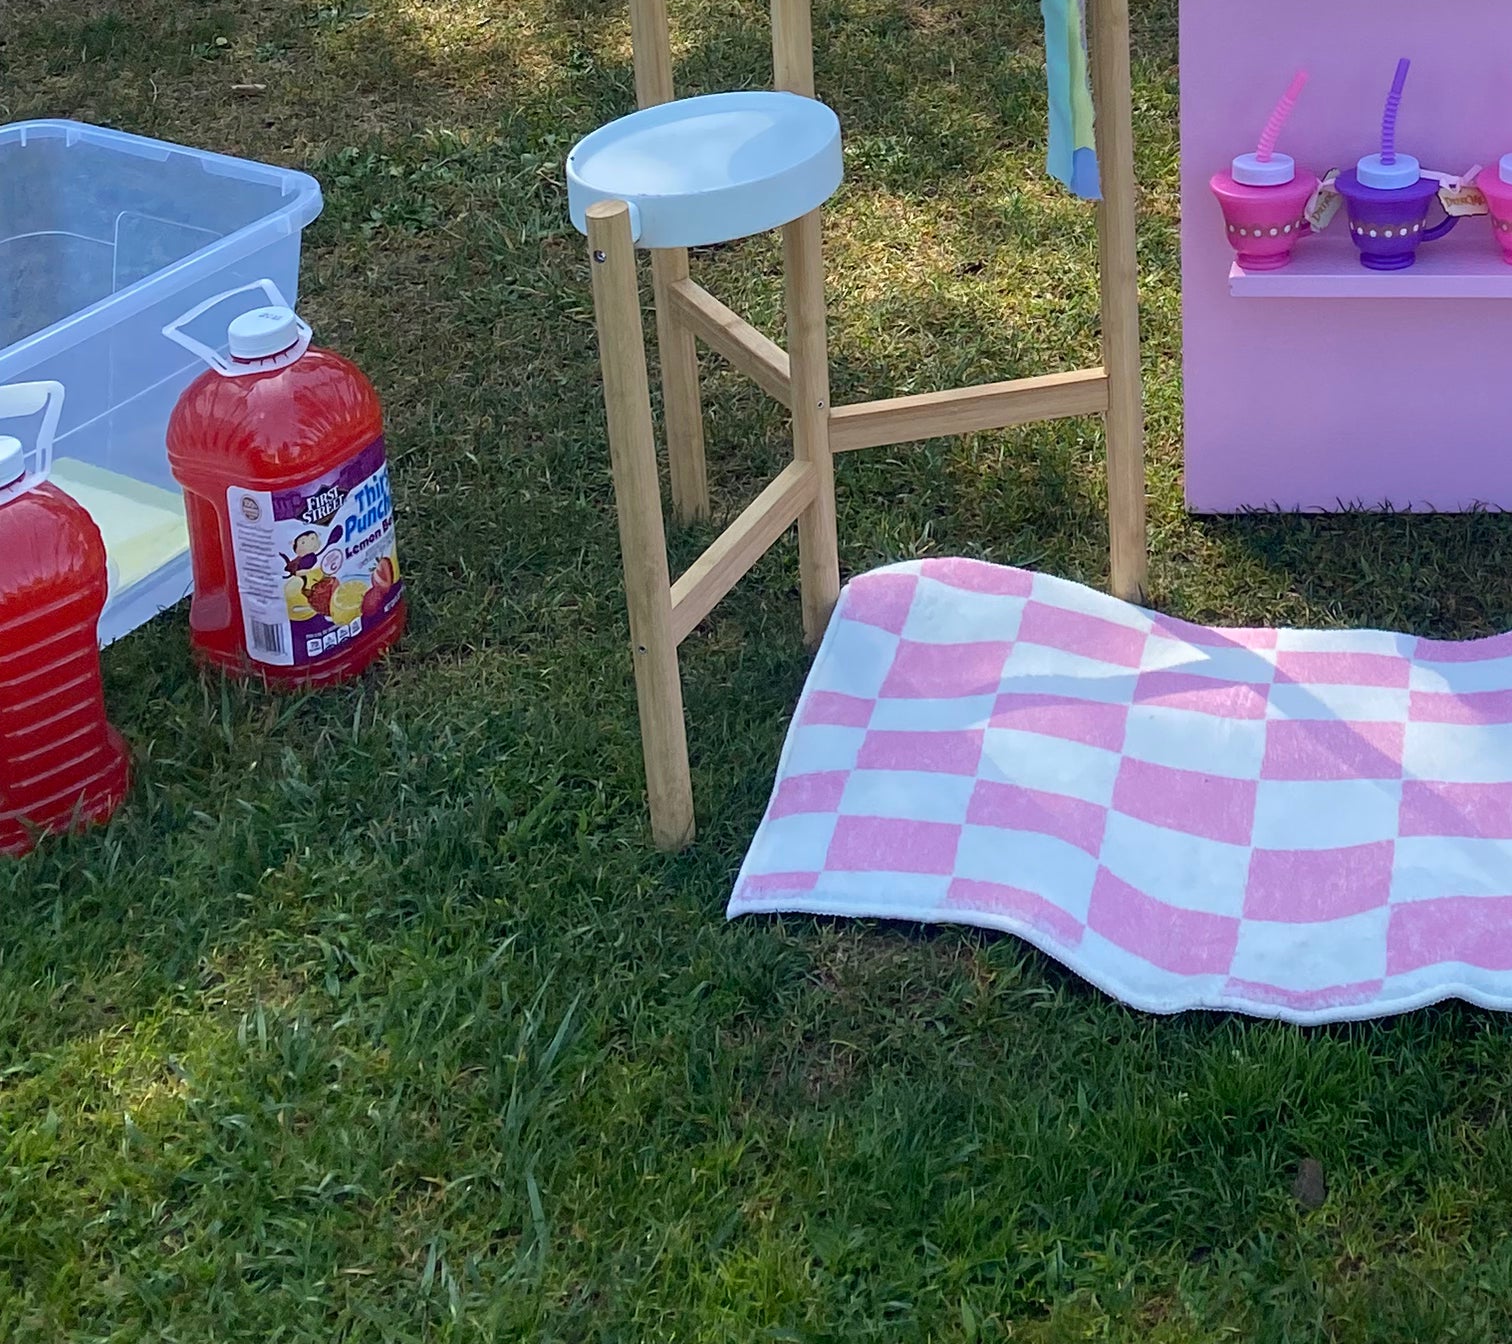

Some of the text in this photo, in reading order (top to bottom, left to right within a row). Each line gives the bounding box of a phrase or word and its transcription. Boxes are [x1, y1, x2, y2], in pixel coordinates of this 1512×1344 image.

[302, 493, 345, 524] STREET
[306, 486, 339, 512] FIRST
[344, 493, 392, 543] Punch
[344, 528, 382, 560] Lemon
